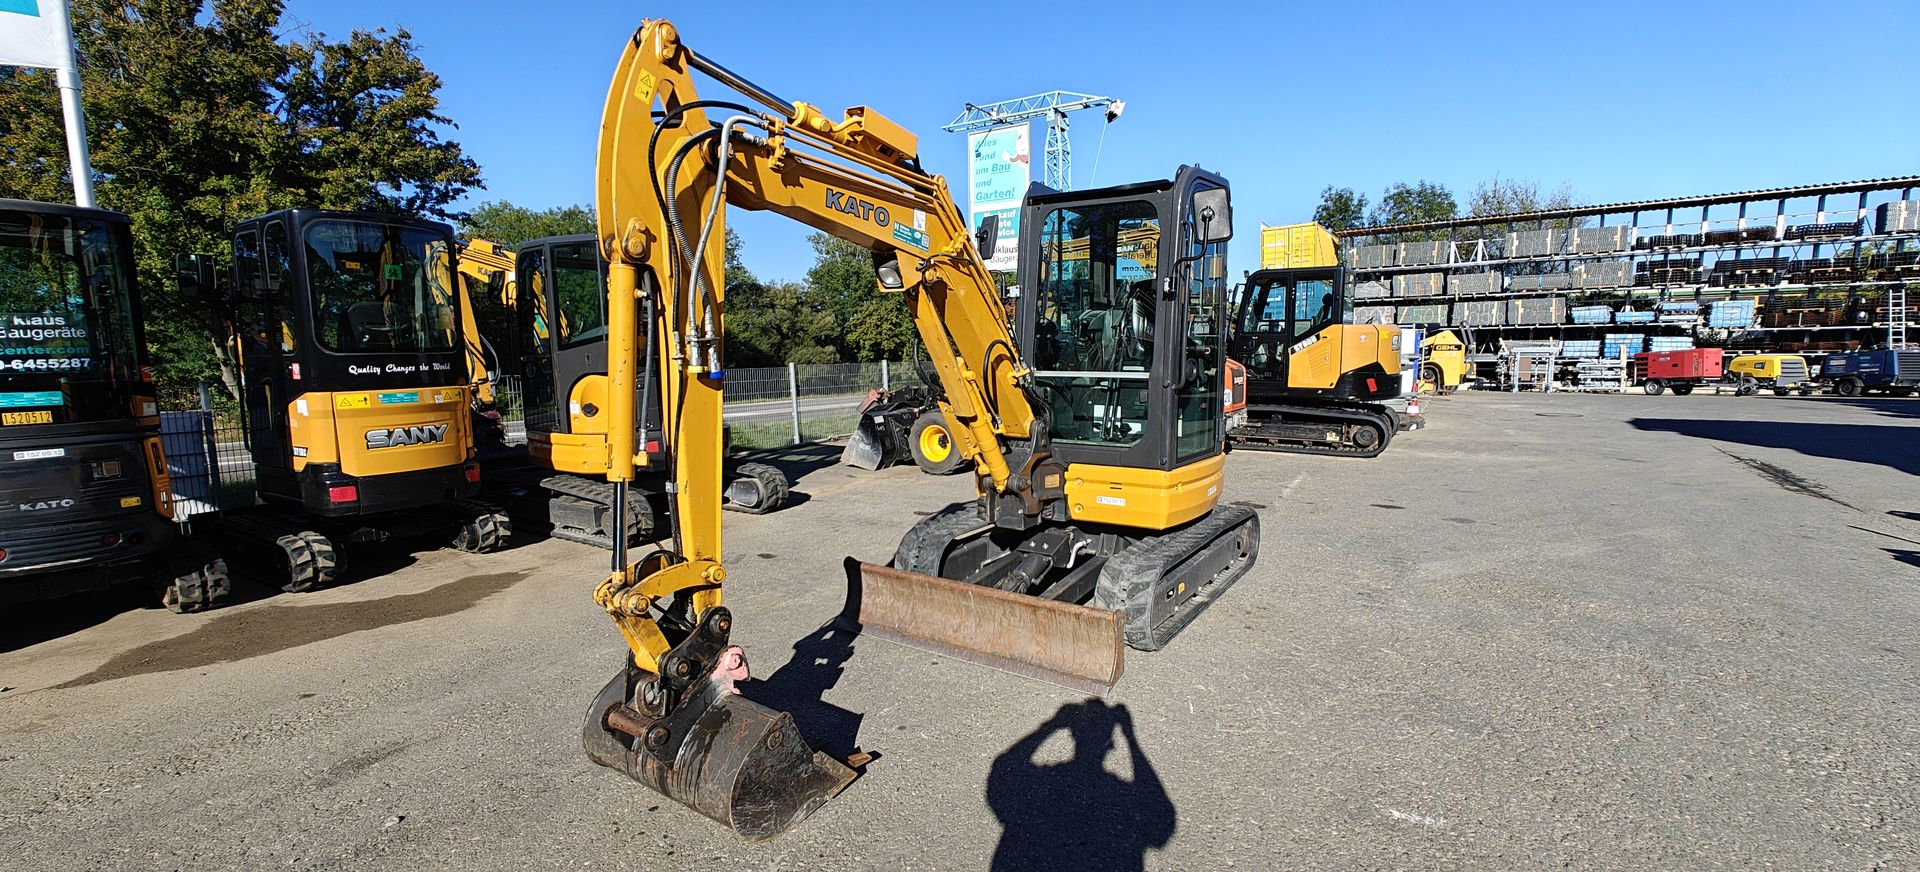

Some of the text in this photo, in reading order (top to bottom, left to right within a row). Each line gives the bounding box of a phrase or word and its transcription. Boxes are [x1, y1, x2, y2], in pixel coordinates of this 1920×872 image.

[976, 152, 996, 162] und
[991, 163, 1011, 173] Bau
[975, 179, 992, 188] und
[976, 188, 1015, 200] Garten!
[825, 187, 890, 227] KATO
[994, 245, 1018, 255] iklaus
[348, 362, 451, 376] Quality Changes the World
[366, 424, 449, 449] SANY
[19, 498, 75, 511] KATO
